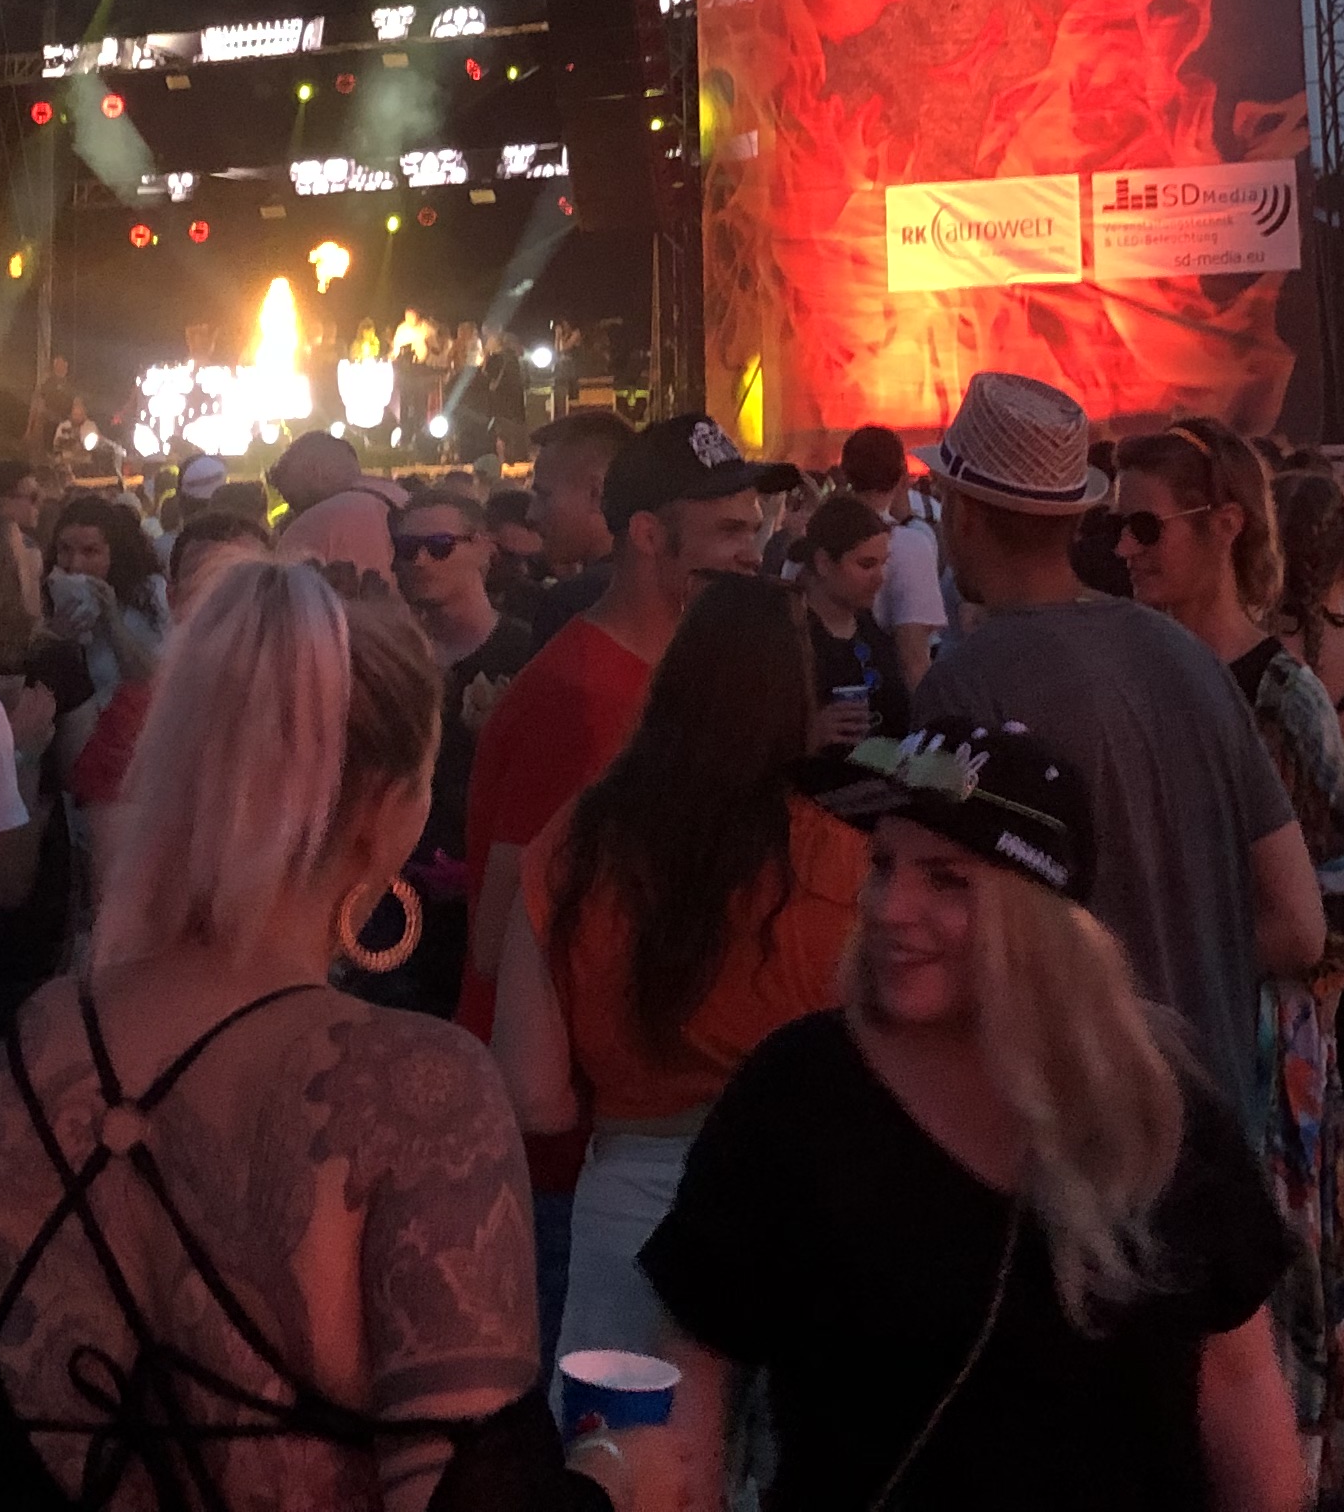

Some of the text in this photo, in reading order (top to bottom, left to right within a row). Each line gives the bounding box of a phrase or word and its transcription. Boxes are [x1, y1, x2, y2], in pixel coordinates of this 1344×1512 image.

[1161, 182, 1259, 208] SD Media
[901, 224, 927, 246] RK
[1174, 250, 1266, 268] sd-media.eu
